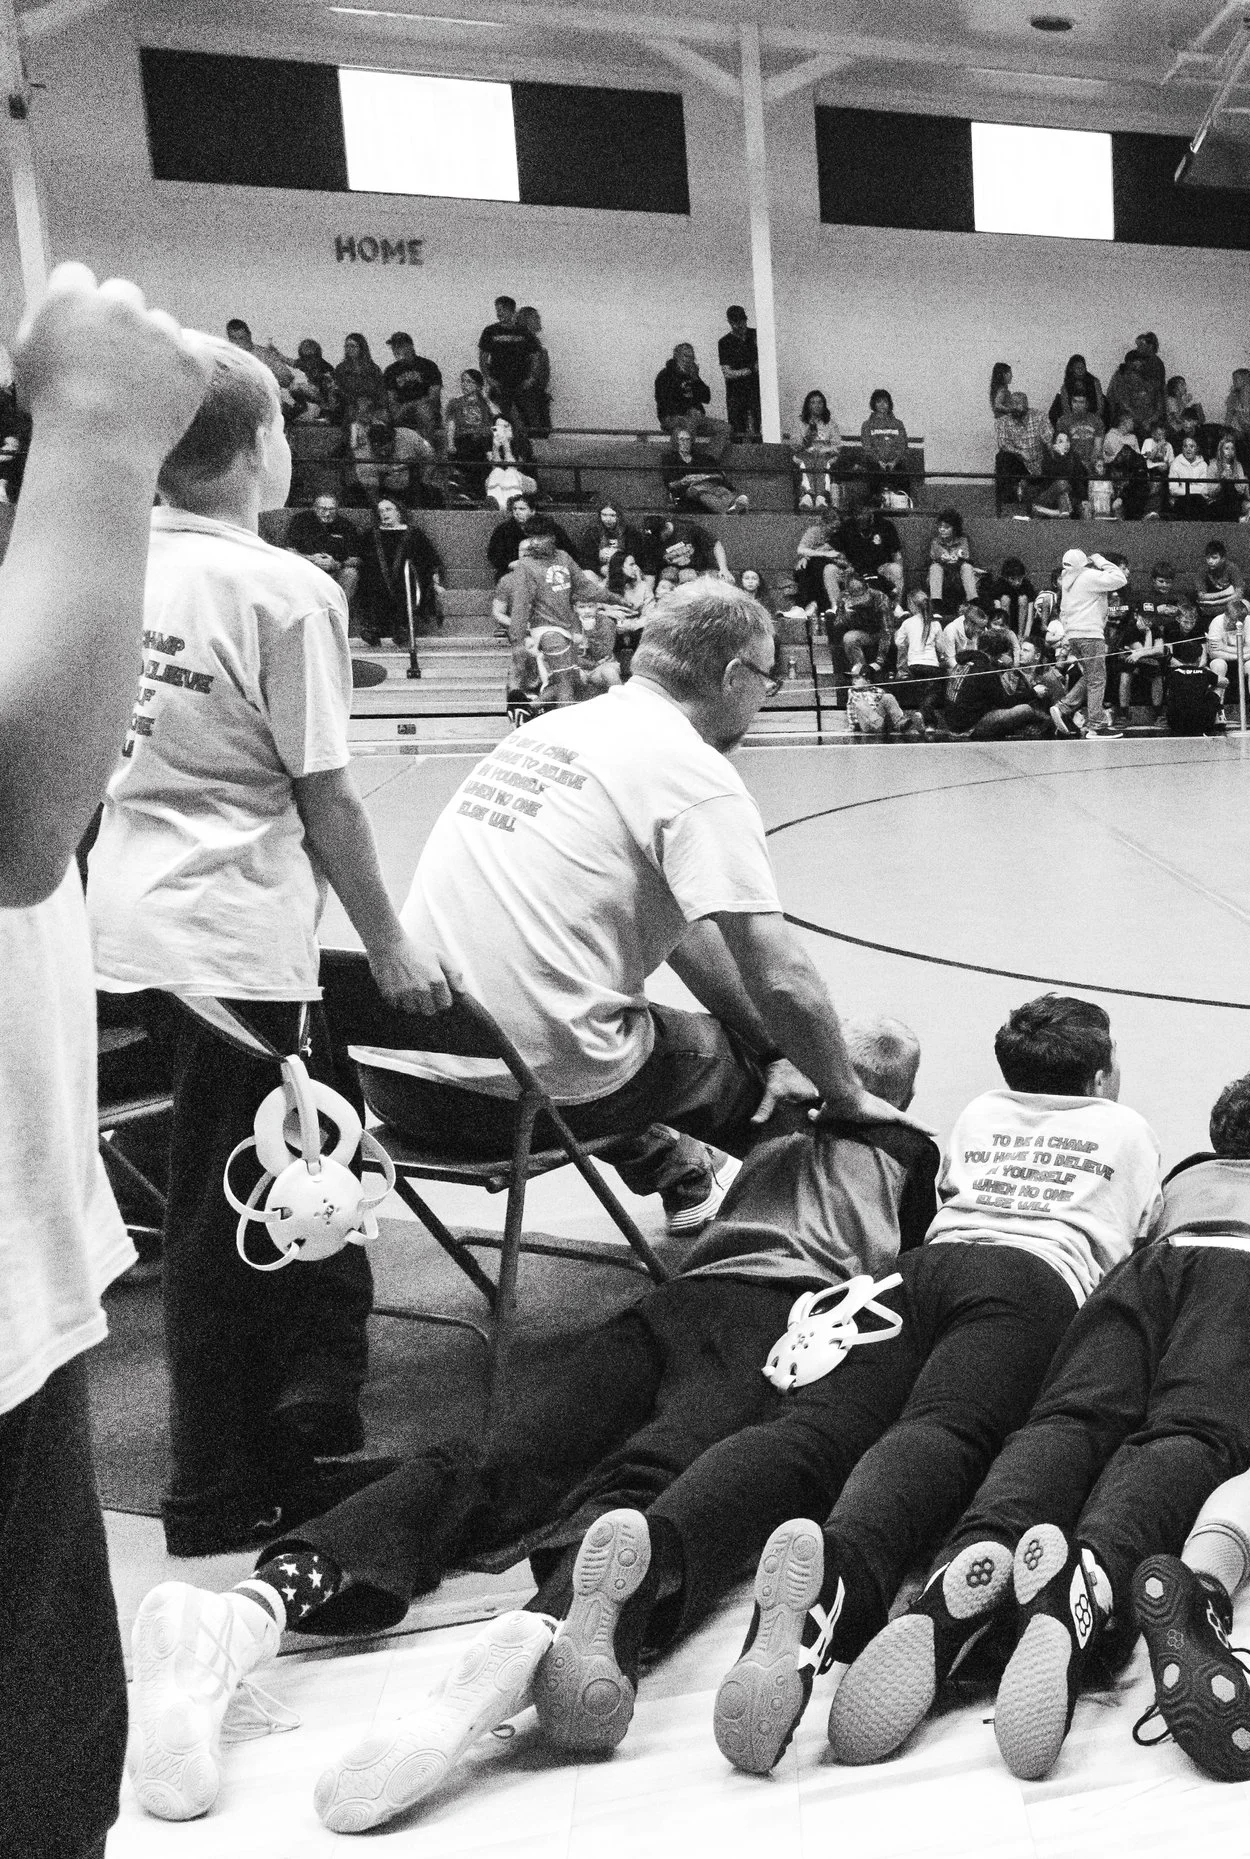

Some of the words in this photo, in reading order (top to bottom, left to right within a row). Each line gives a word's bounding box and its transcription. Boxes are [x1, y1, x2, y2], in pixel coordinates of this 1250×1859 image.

[334, 235, 424, 266] HOME
[139, 659, 215, 695] ELIEVE
[521, 755, 540, 770] TO
[495, 789, 514, 807] NO
[512, 797, 543, 818] ONE
[488, 811, 517, 833] WILL
[992, 1134, 1011, 1148] TO
[1013, 1136, 1033, 1148] BE
[1034, 1136, 1045, 1148] A
[1048, 1136, 1099, 1154] CHAMP
[964, 1151, 991, 1164] YOU
[1032, 1151, 1052, 1165] TO
[1053, 1154, 1115, 1182] BELIEVE
[1002, 1165, 1077, 1186] YOURSELF
[972, 1178, 1017, 1197] WHEN
[1018, 1185, 1040, 1199] NO
[1042, 1188, 1074, 1202] ONE
[976, 1194, 1015, 1210] ELSE
[1018, 1201, 1051, 1213] WILL
